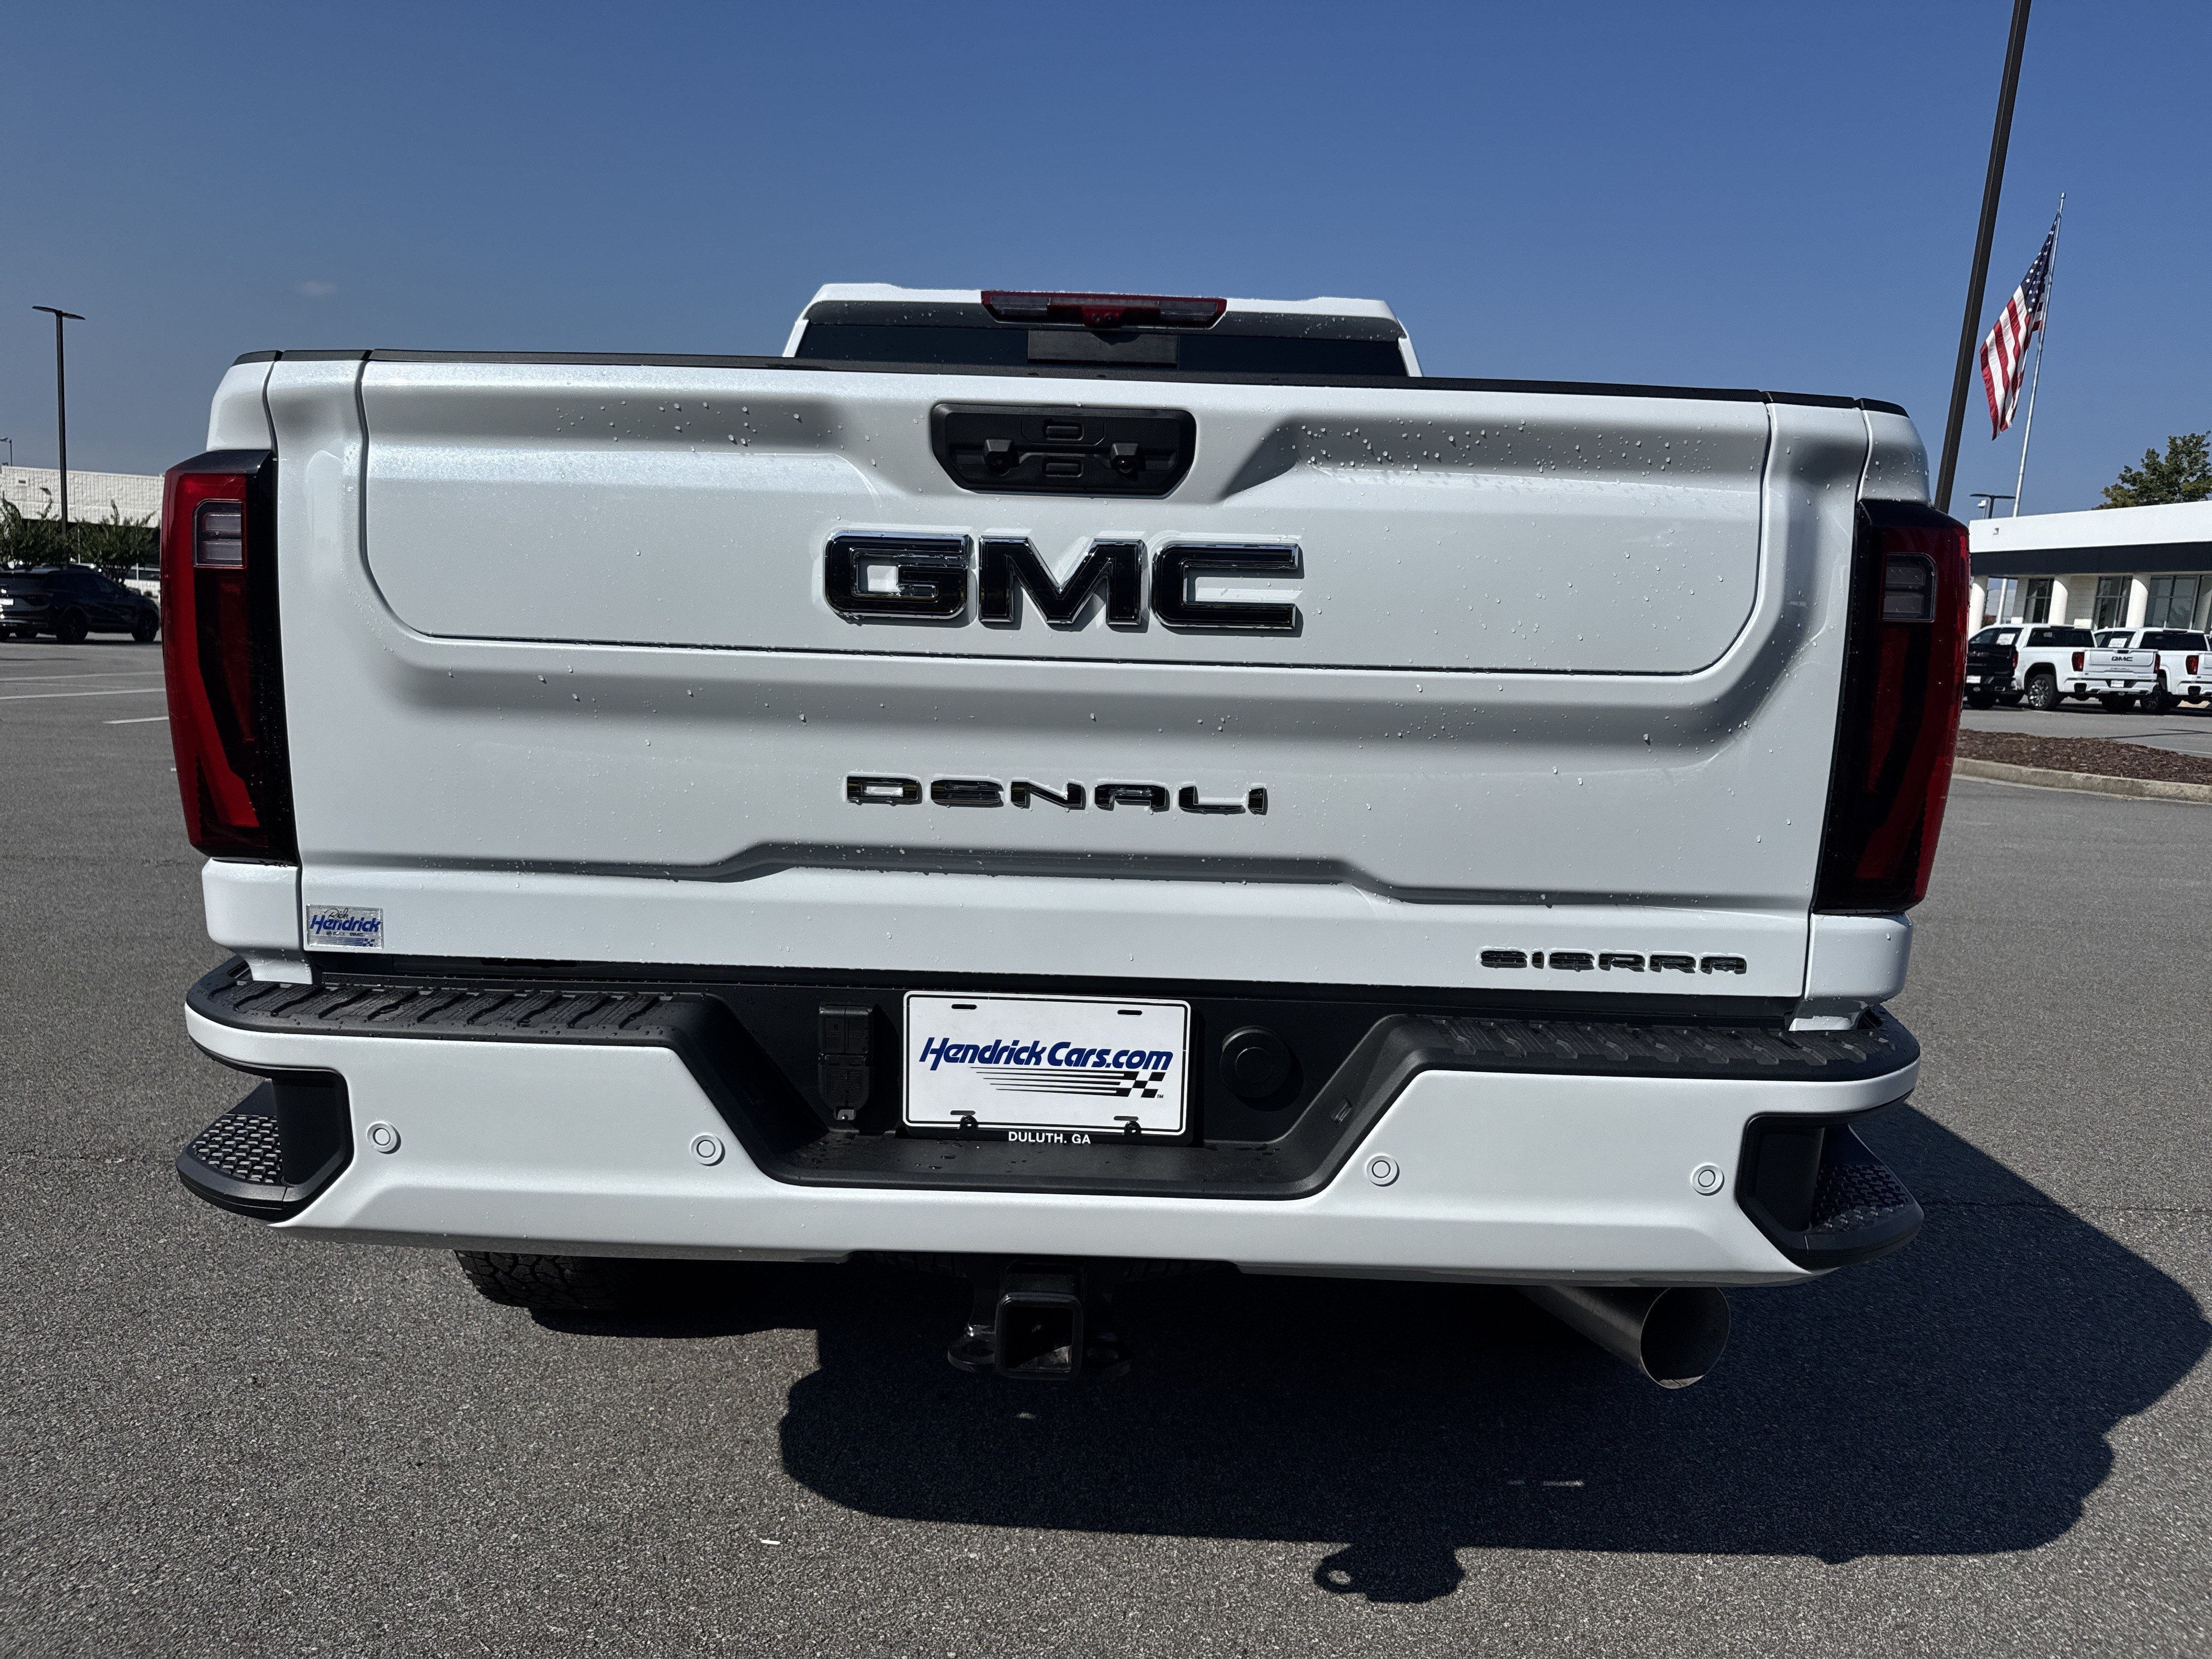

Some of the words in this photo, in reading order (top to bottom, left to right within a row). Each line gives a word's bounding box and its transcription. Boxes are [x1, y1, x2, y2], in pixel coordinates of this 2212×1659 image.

[825, 529, 1300, 630] GMC
[845, 775, 1268, 814] DENALI
[310, 915, 382, 934] Hendrick
[1480, 950, 1747, 975] SIERRA
[1071, 1133, 1091, 1144] GA
